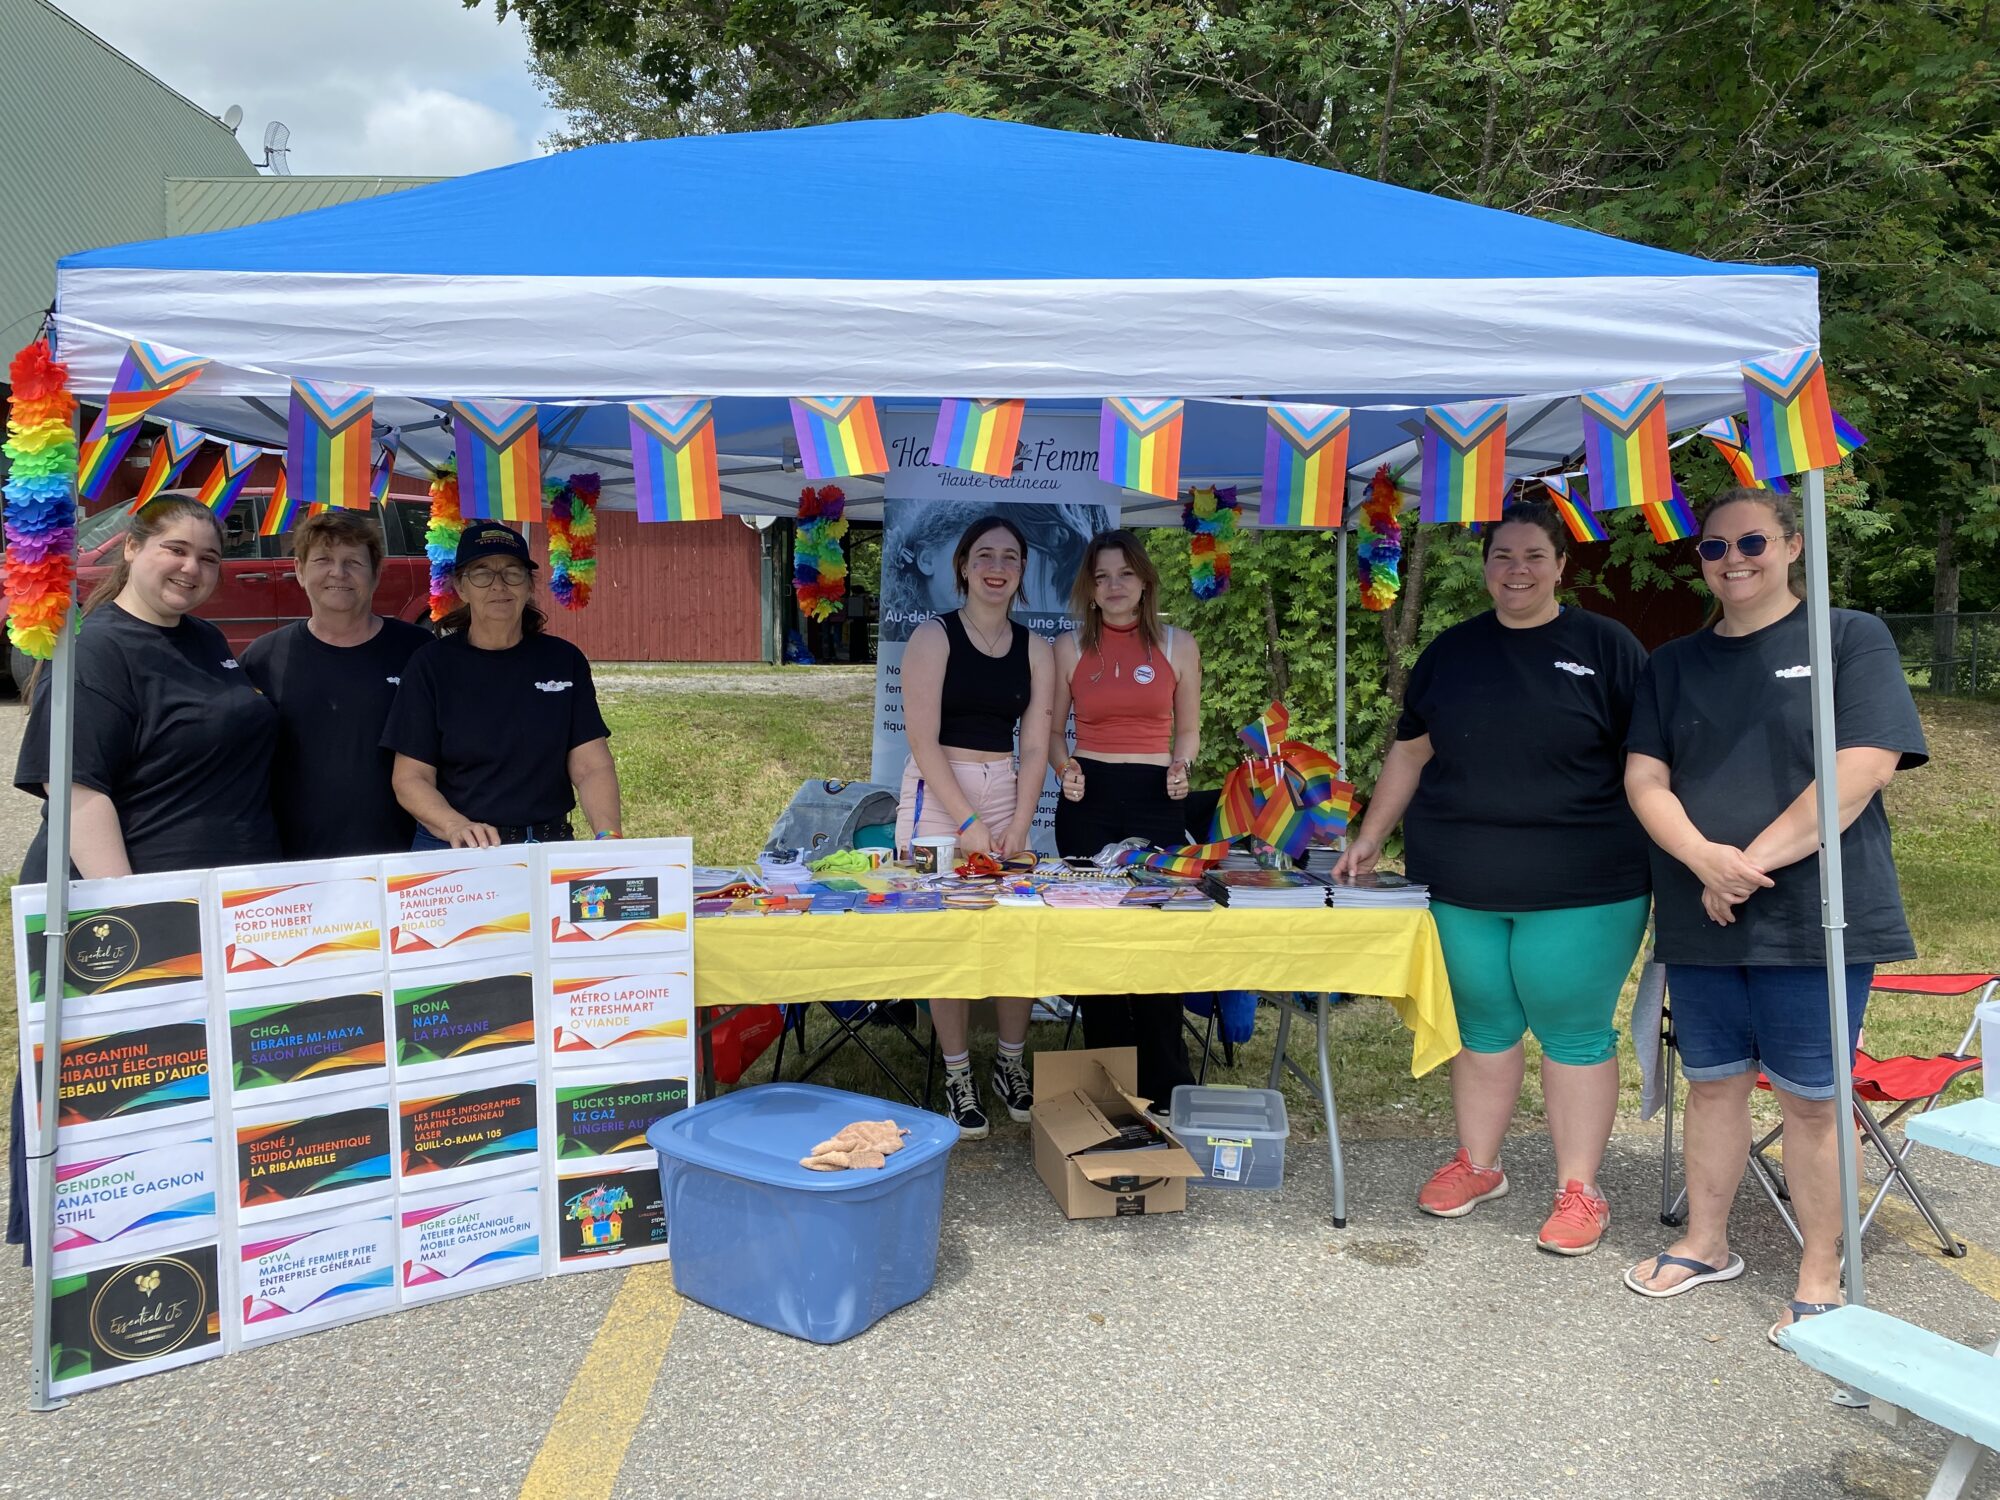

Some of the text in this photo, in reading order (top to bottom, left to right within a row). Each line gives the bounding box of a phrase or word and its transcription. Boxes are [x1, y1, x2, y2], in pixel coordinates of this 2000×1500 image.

[1034, 438, 1099, 471] Femm
[938, 472, 1061, 490] Haute-Gatineau
[1028, 618, 1054, 629] une
[884, 704, 898, 712] ou
[399, 884, 463, 899] BRANCHAUD
[400, 891, 500, 910] FAMILIPRIX GINA ST-
[234, 903, 313, 920] MCCONNERY
[401, 907, 448, 921] JACQUES
[235, 915, 312, 932] FORD HUBERT
[236, 920, 373, 944] ÉQUIPEMENT MANIWAKI
[570, 988, 669, 1004] MÉTRO LAPOINTE
[412, 1000, 450, 1015] RONA
[570, 1002, 654, 1016] KZ FRESHMART
[413, 1013, 449, 1028] NAPA
[570, 1016, 630, 1029] O'VIANDE
[250, 1024, 290, 1038] CHGA
[251, 1026, 364, 1052] LIBRAIRE MI-MAYA
[414, 1020, 489, 1041] LA PAYSANE
[61, 1043, 148, 1068] ARGANTINI
[251, 1042, 344, 1065] SALON MICHEL
[59, 1049, 207, 1083] HIBAULT ÉLECTRIQUE
[58, 1063, 209, 1099] EBEAU VITRE D'AUTO
[414, 1097, 521, 1122] LES FILLES INFOGRAPHES
[572, 1097, 614, 1110] BUCK'S
[618, 1093, 653, 1106] SPORT
[414, 1110, 504, 1132] MARTIN COUSINEAU
[572, 1109, 616, 1122] KZ GAZ
[573, 1121, 624, 1135] LINGERIE
[628, 1118, 644, 1130] AU
[250, 1136, 295, 1153] SIGNÉ J
[414, 1130, 442, 1142] LASER
[415, 1129, 502, 1152] QUILL-O-RAMA 105
[250, 1135, 371, 1165] STUDIO AUTHENTIQUE
[251, 1153, 337, 1177] LA RIBAMBELLE
[56, 1171, 135, 1195] GENDRON
[57, 1171, 204, 1211] ANATOLE GAGNON
[57, 1208, 96, 1225] STIHL
[420, 1212, 480, 1231] TIGRE GÉANT
[420, 1215, 514, 1241] ATELIER MÉCANIQUE
[420, 1221, 531, 1252] MOBILE GASTON MORIN
[259, 1252, 291, 1265] GYVA
[259, 1244, 377, 1276] MARCHÉ FERMIER PITRE
[420, 1250, 446, 1261] MAXI
[260, 1255, 371, 1287] ENTREPRISE GÉNÉRALE
[260, 1285, 286, 1298] AGA
[110, 1302, 162, 1334] Essentiel
